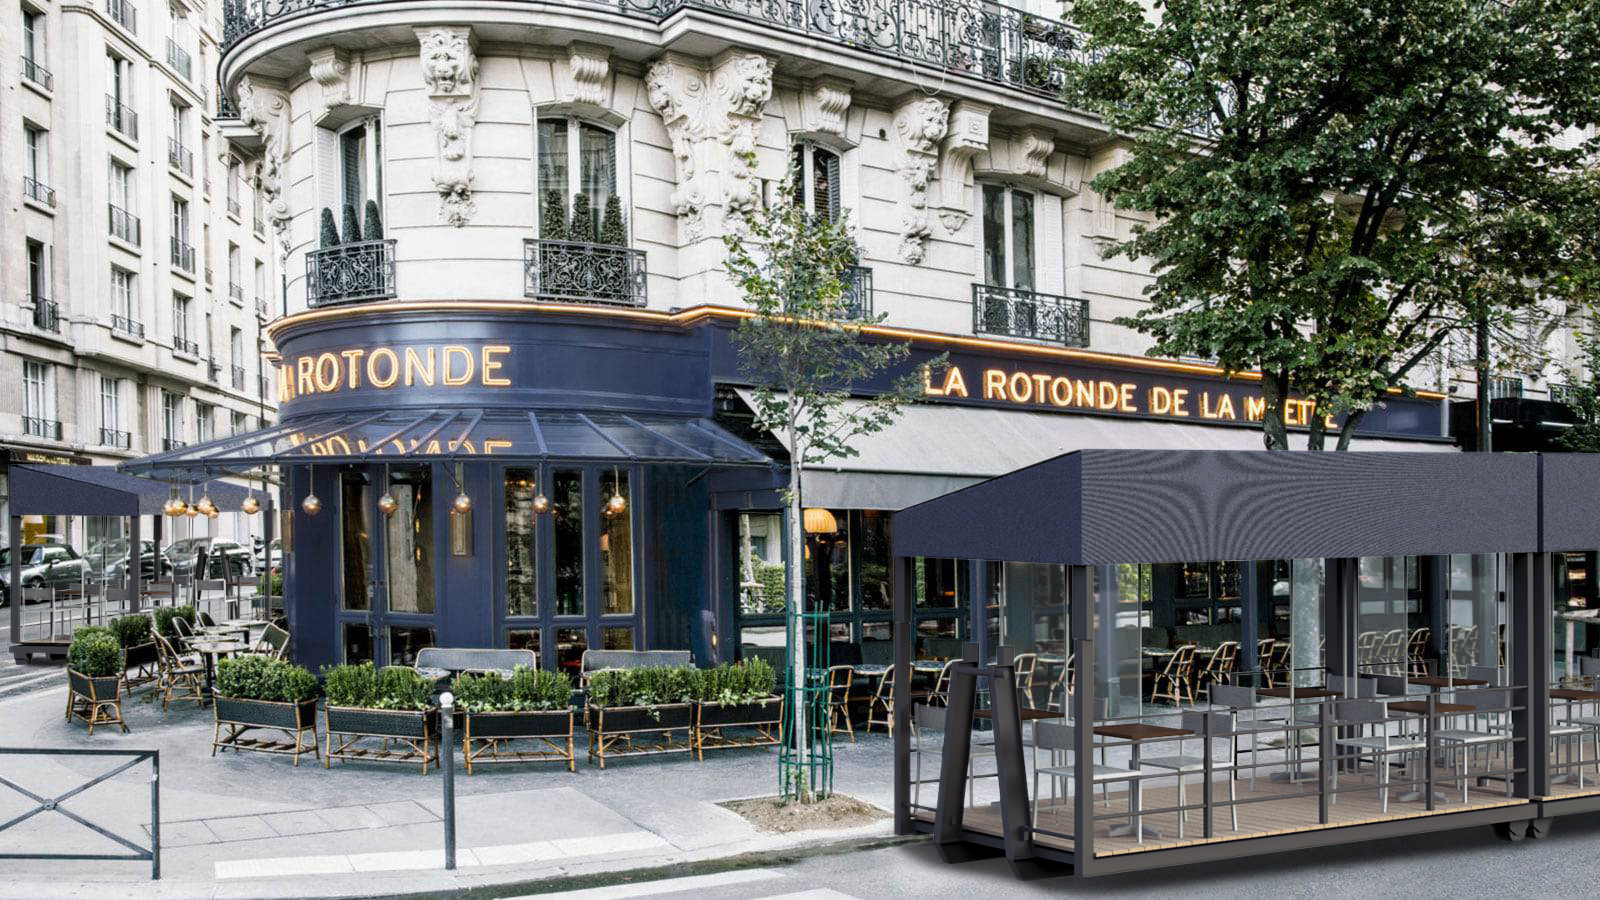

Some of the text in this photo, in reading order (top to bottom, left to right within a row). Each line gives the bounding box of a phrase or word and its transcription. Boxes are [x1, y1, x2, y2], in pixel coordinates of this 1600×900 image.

[298, 346, 511, 394] ROTONDE
[924, 364, 968, 397] LA
[984, 369, 1138, 412] ROTONDE
[1150, 386, 1189, 417] DE
[1202, 392, 1236, 420] LA
